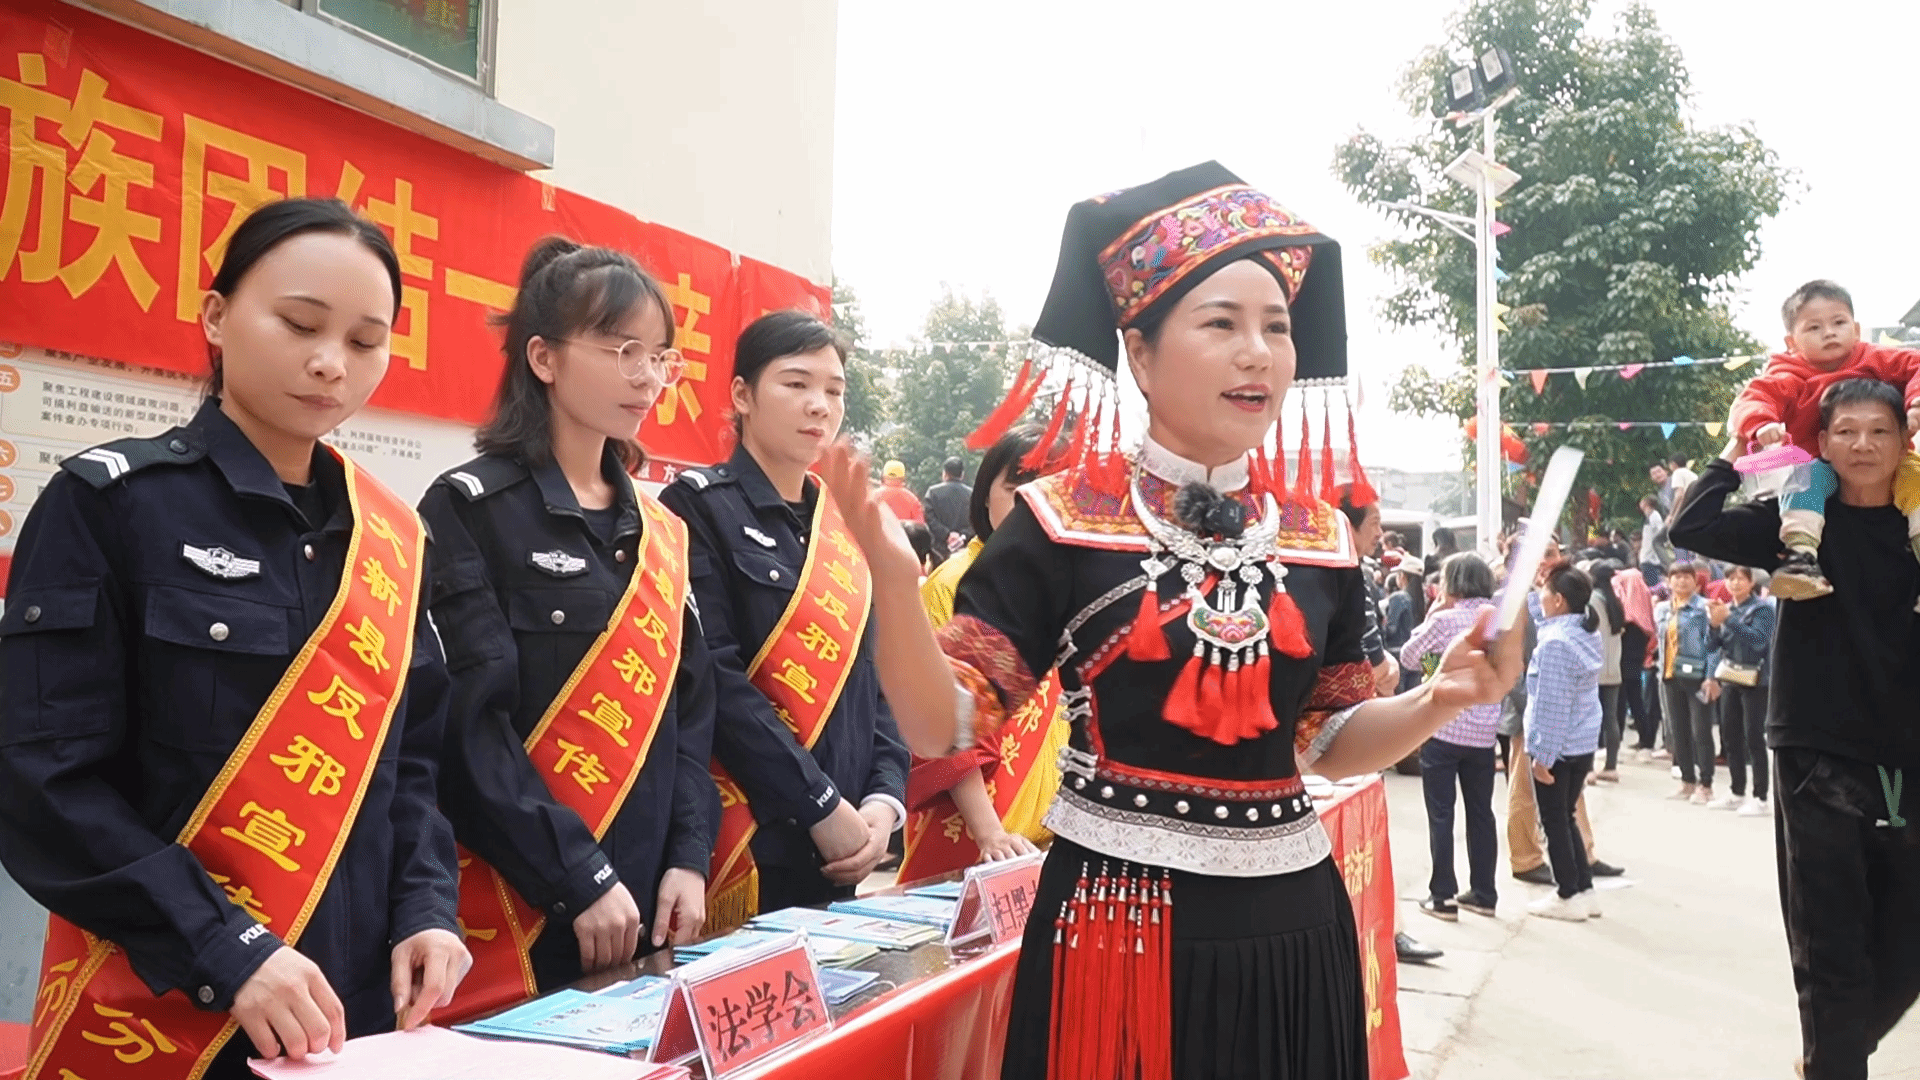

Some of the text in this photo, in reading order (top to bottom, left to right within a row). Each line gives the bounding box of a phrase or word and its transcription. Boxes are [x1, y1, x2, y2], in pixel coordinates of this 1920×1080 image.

[0, 53, 711, 425] 族团结一亲
[992, 879, 1039, 936] 扫黑
[707, 970, 818, 1062] 法学会
